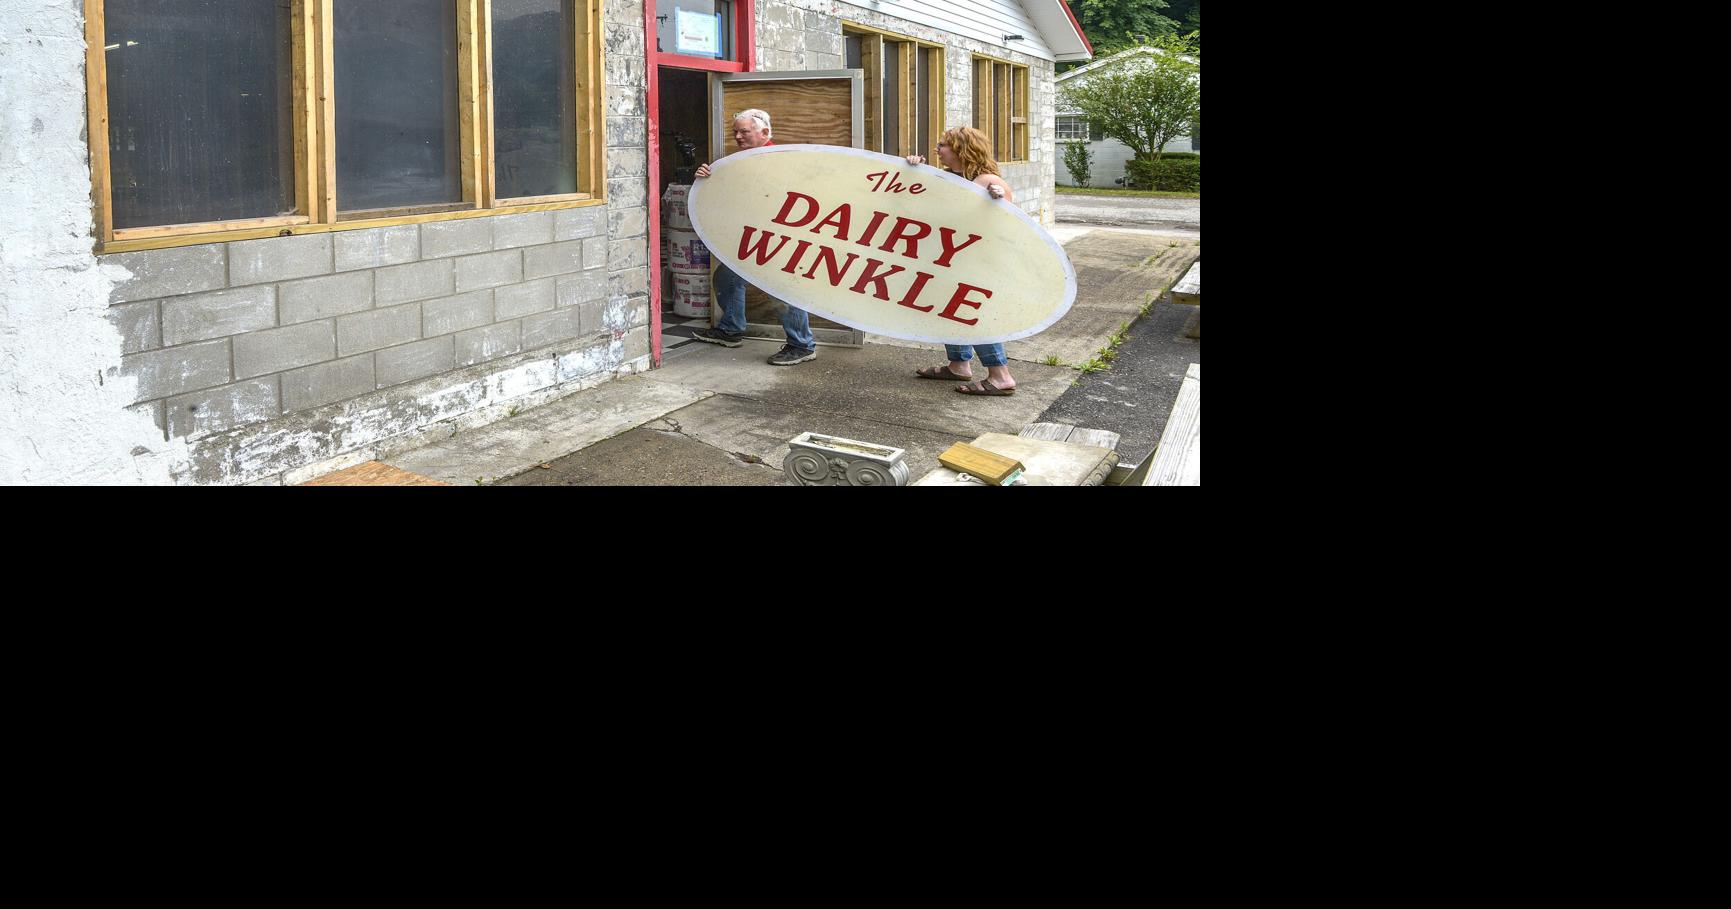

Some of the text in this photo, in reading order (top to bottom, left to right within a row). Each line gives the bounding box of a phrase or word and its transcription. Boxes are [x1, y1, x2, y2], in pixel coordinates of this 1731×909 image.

[866, 171, 926, 194] The
[772, 191, 982, 268] DAIRY
[737, 226, 992, 326] WINKLE
